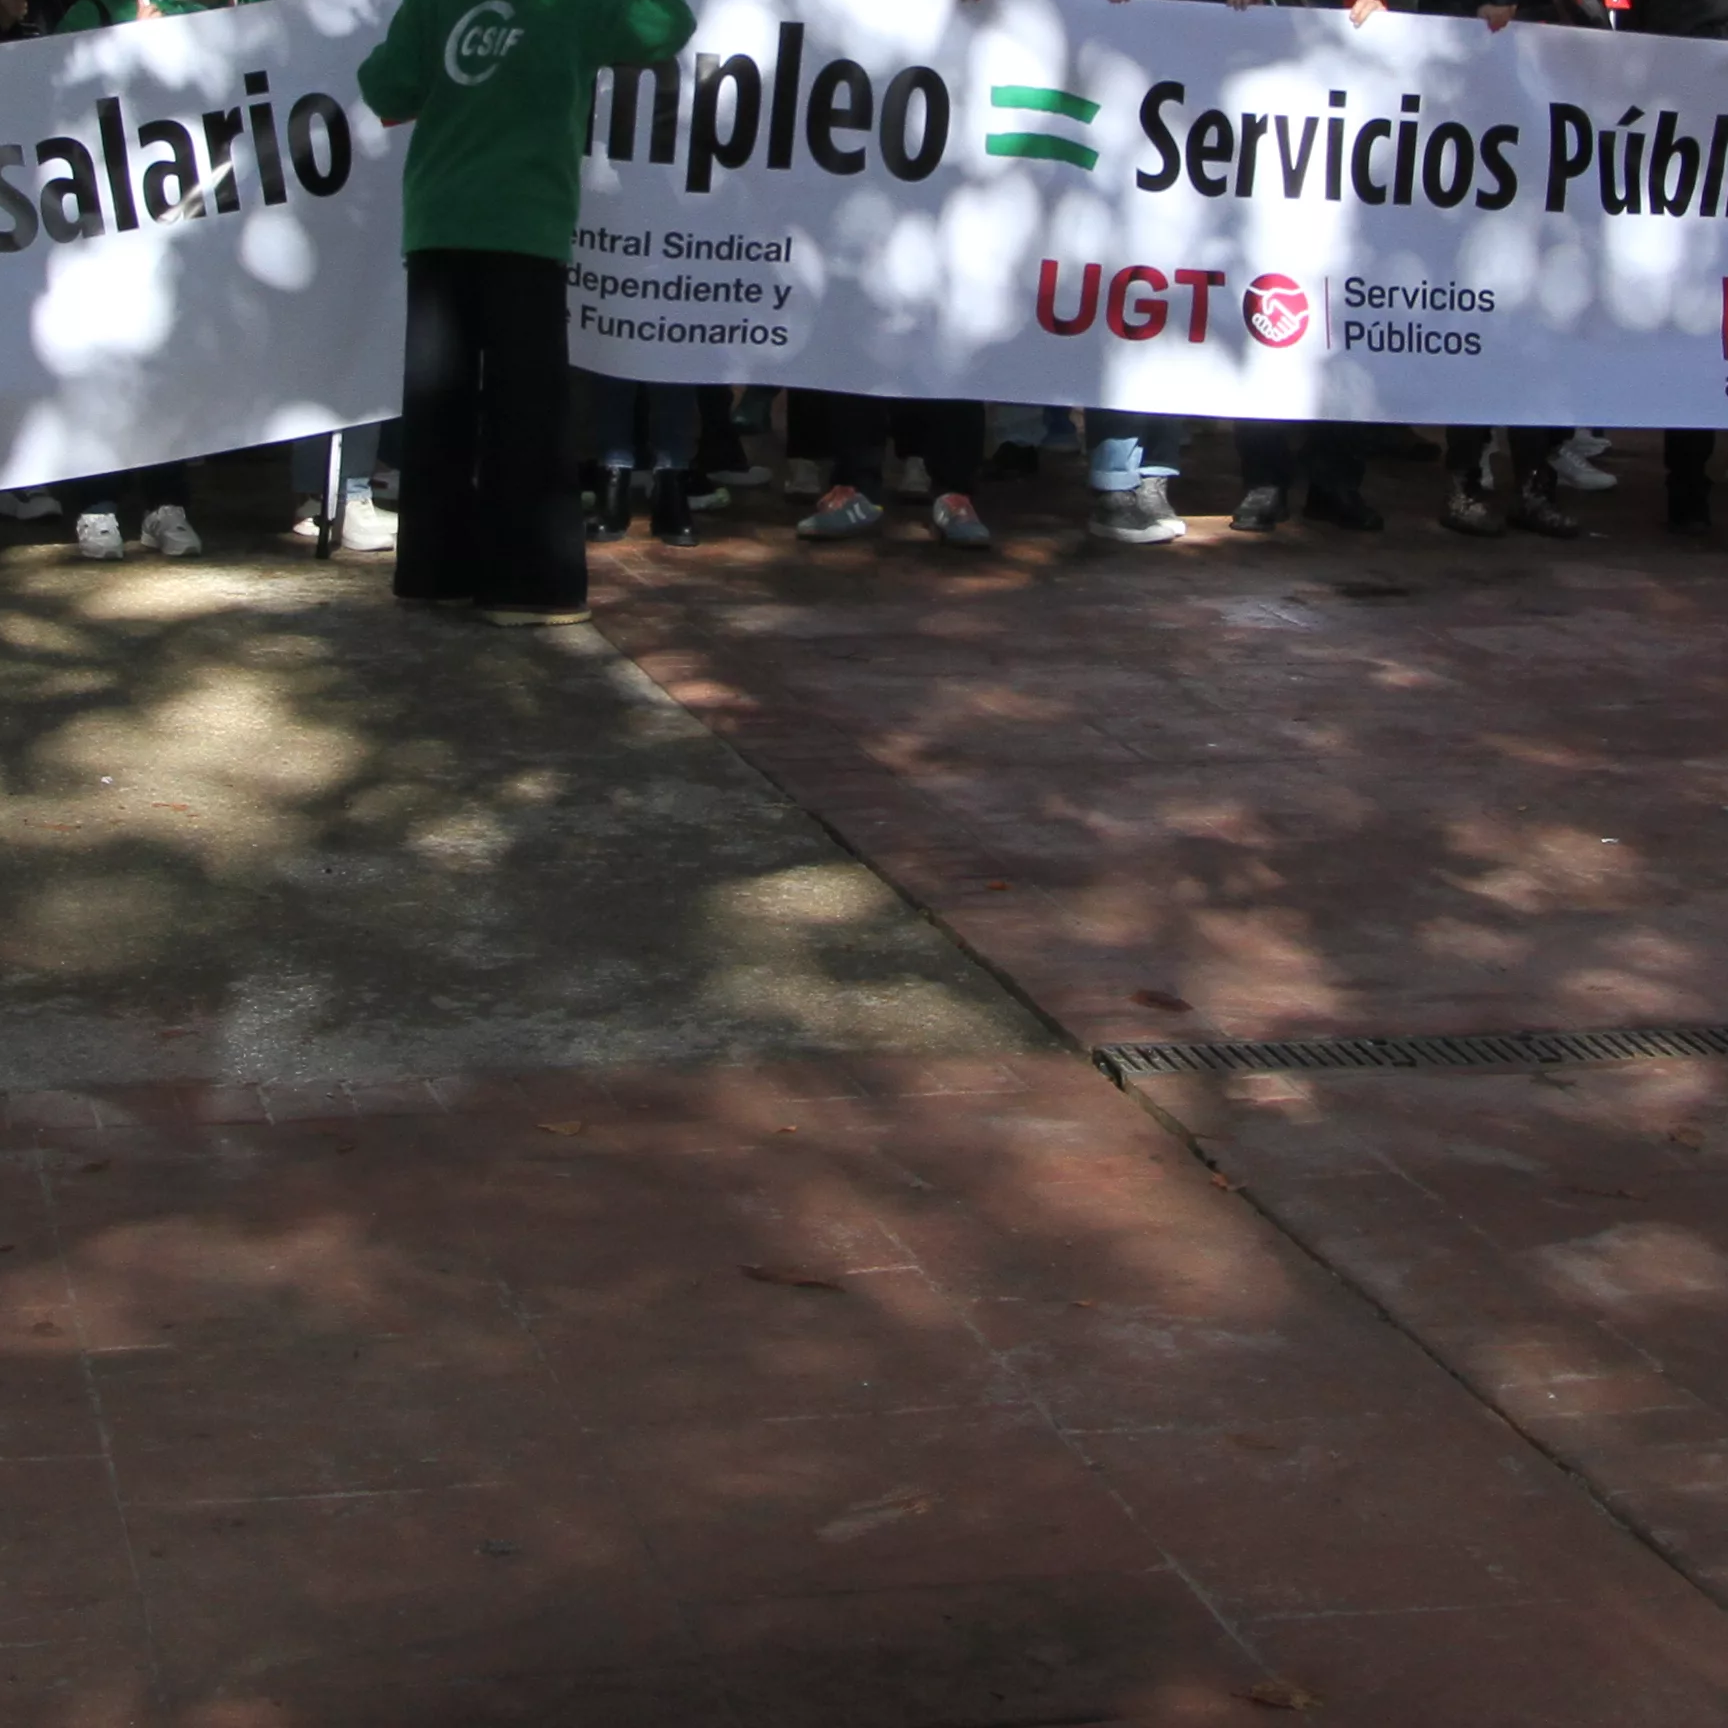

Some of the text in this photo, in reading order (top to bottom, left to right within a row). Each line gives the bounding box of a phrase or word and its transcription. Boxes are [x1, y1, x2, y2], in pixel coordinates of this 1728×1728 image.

[461, 25, 525, 57] CSIF
[582, 21, 951, 194] mpleo
[1135, 80, 1521, 212] Servicios
[662, 231, 793, 263] Sindical
[566, 262, 793, 310] dependiente y
[1035, 258, 1226, 344] UGT
[1344, 276, 1496, 312] Servicios
[580, 304, 790, 346] Funcionarios
[1344, 321, 1483, 356] Públicos
